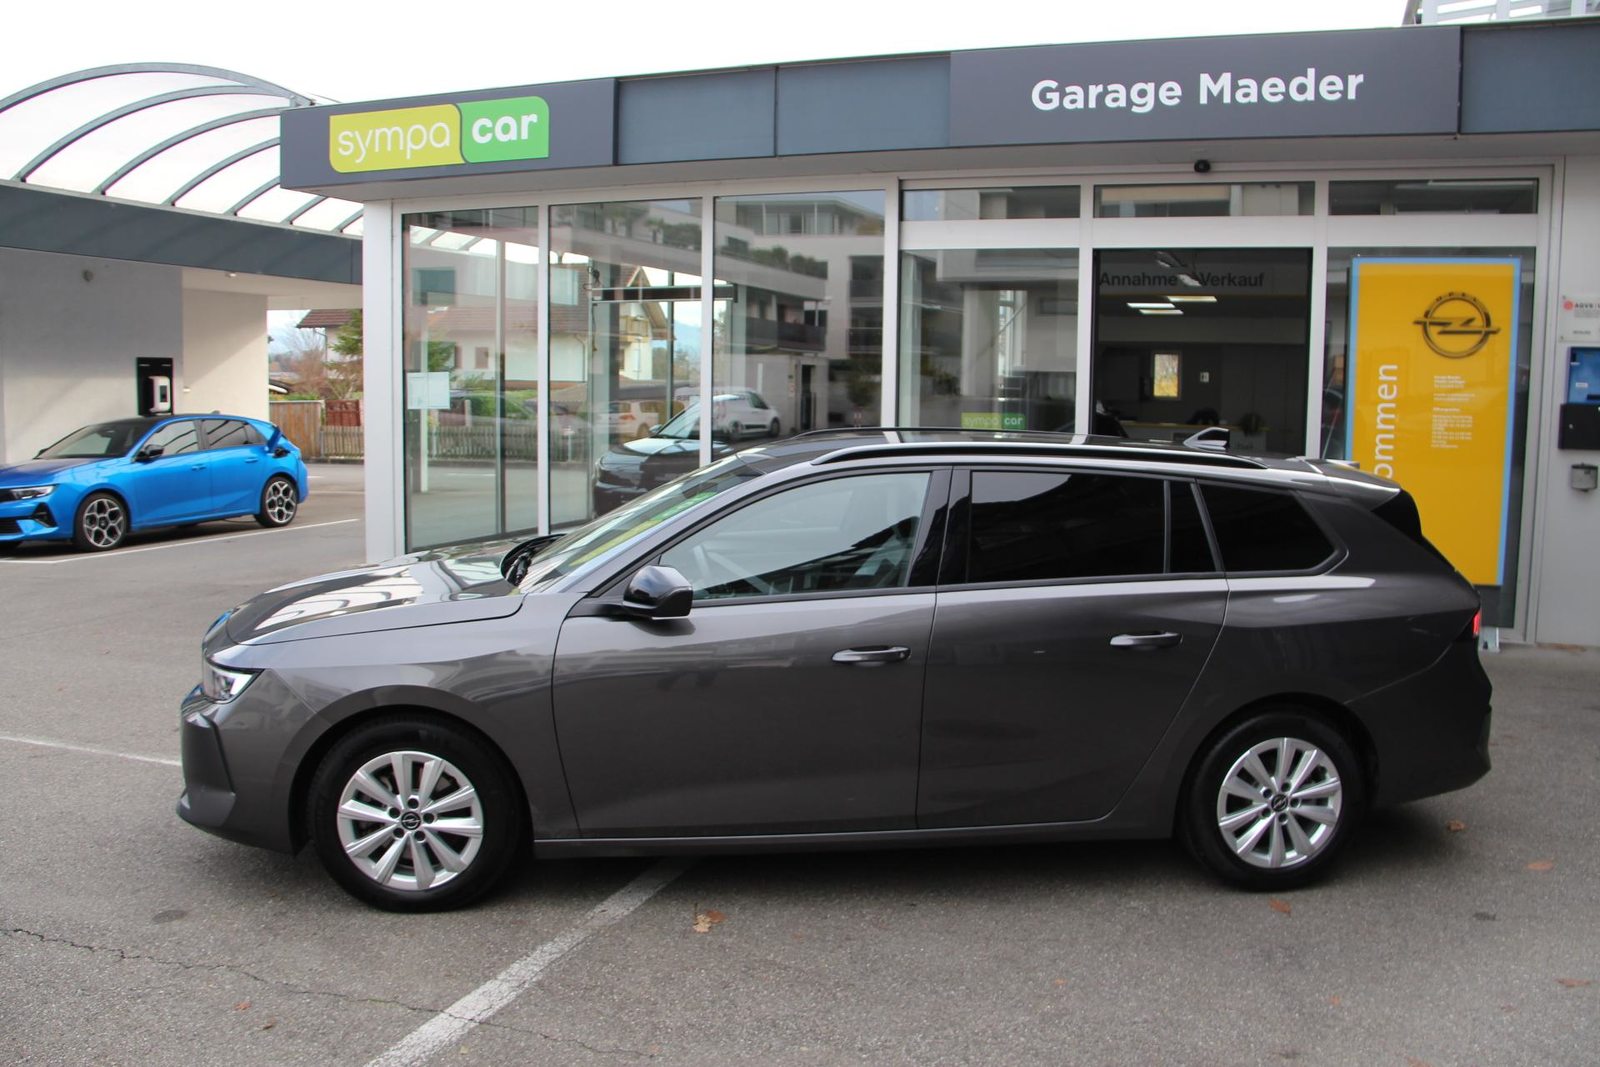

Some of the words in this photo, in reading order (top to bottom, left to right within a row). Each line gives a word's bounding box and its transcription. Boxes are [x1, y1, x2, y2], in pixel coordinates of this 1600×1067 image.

[1031, 79, 1182, 113] Garage
[1199, 68, 1364, 104] Maeder
[337, 121, 451, 163] sympa
[471, 112, 538, 144] car
[1100, 272, 1178, 286] Annahme
[1199, 272, 1264, 286] Verkauf
